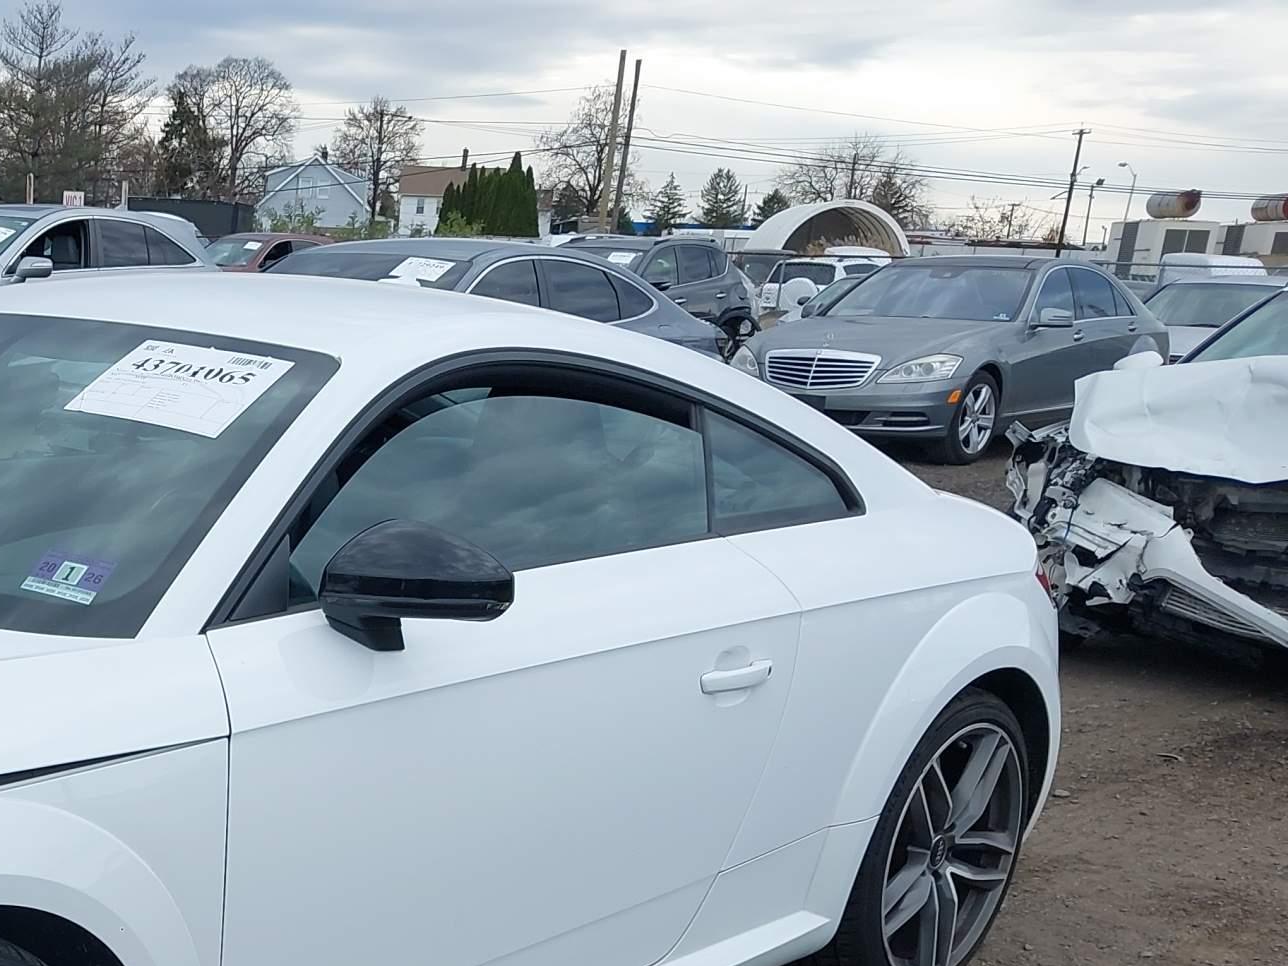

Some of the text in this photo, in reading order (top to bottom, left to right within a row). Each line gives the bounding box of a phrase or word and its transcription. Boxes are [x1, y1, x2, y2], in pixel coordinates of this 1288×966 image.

[131, 356, 258, 386] 43701065
[39, 560, 104, 585] 20 1 26
